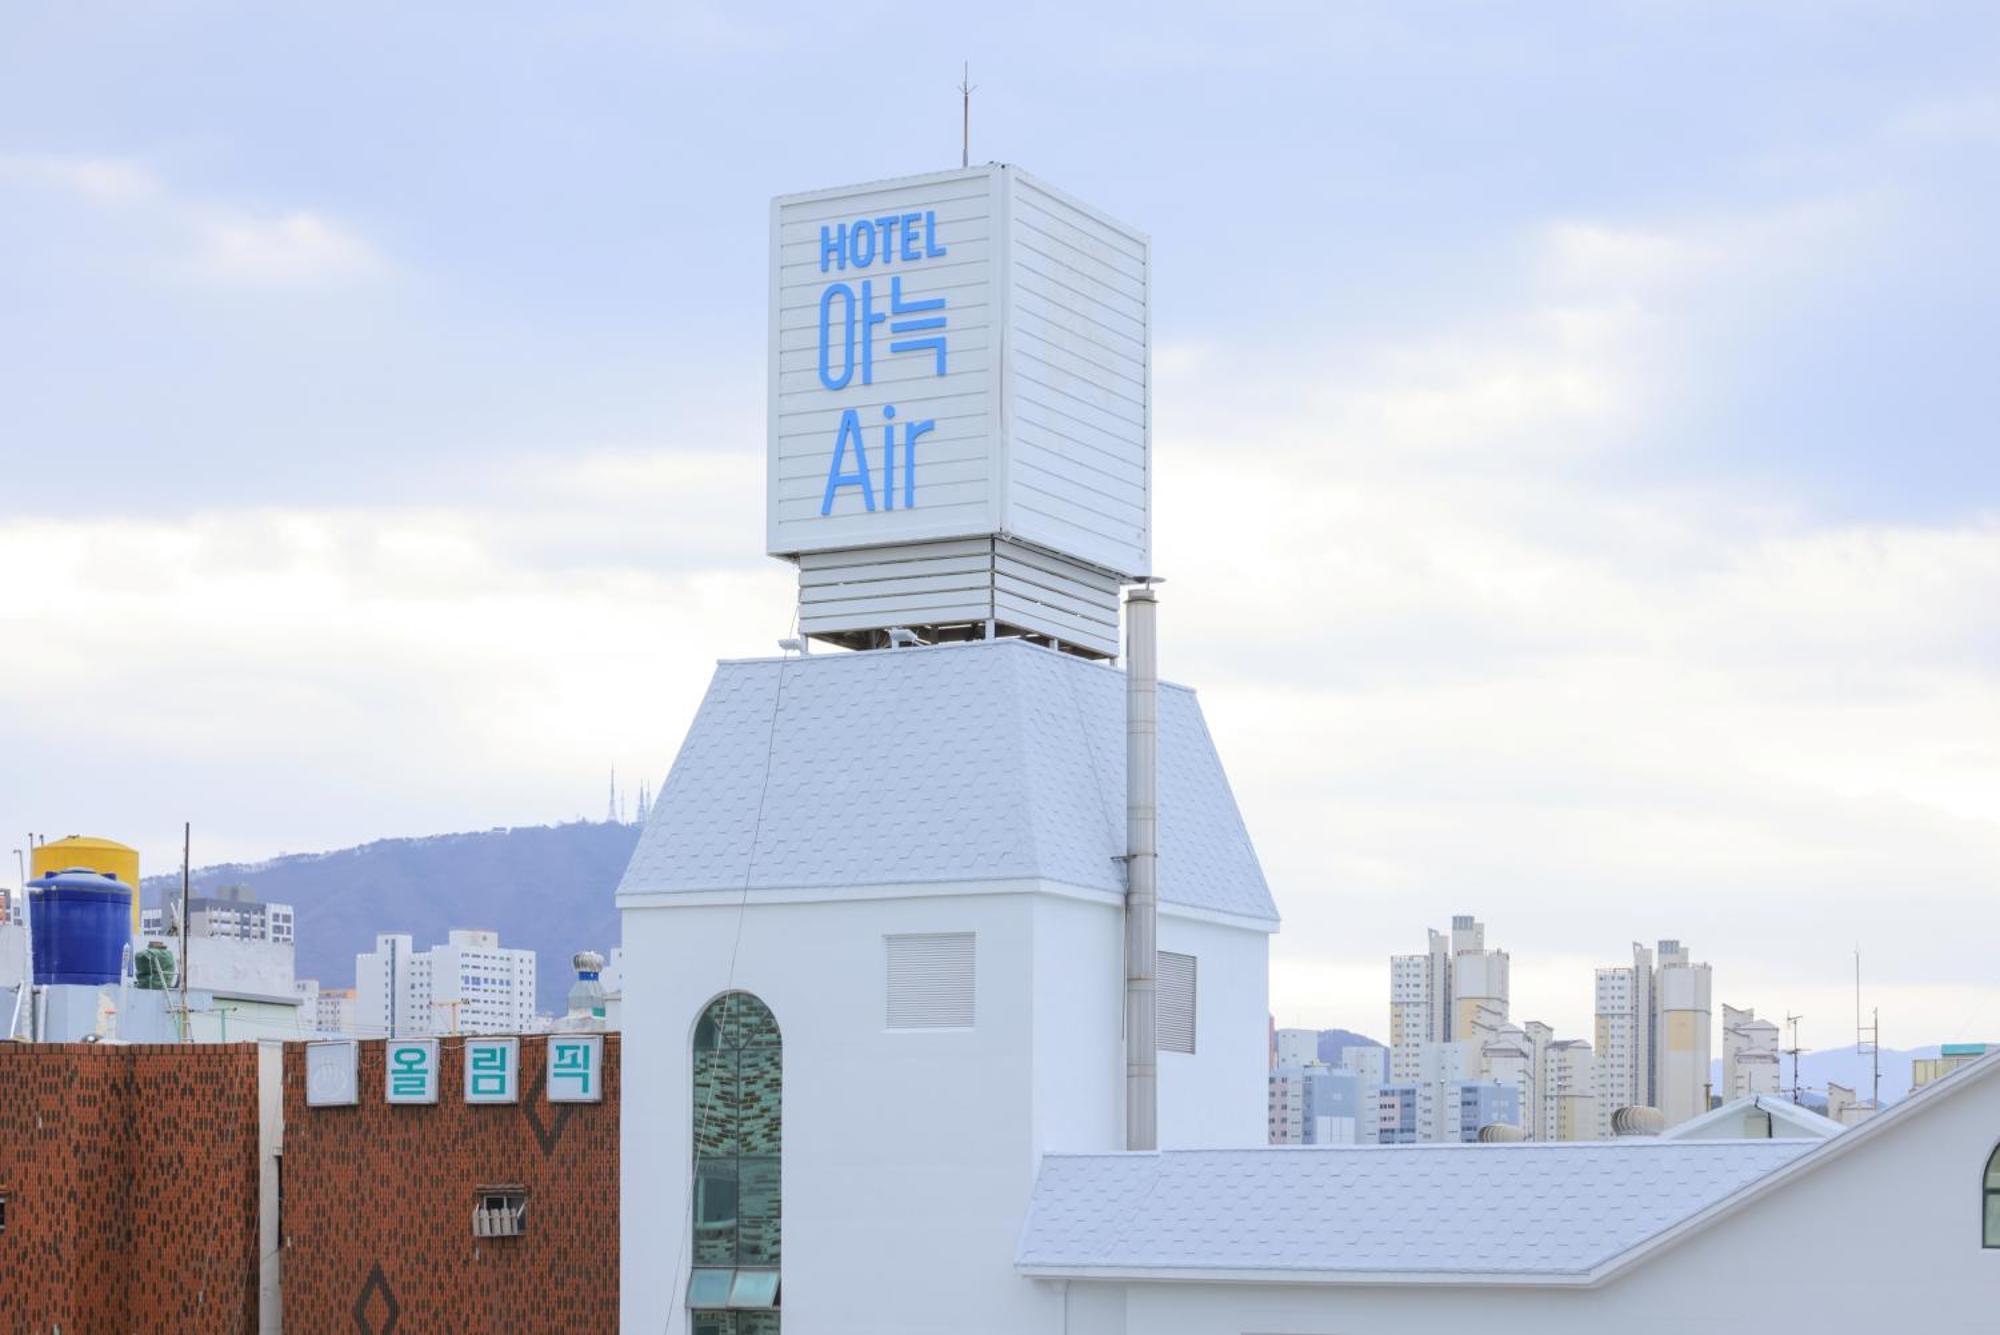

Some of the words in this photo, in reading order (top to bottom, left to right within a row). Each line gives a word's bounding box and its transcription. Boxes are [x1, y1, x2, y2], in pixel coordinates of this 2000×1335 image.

[820, 211, 946, 272] HOTEL
[818, 276, 947, 391] 아늑
[821, 405, 935, 515] Air
[391, 1043, 591, 1097] 올림픽
